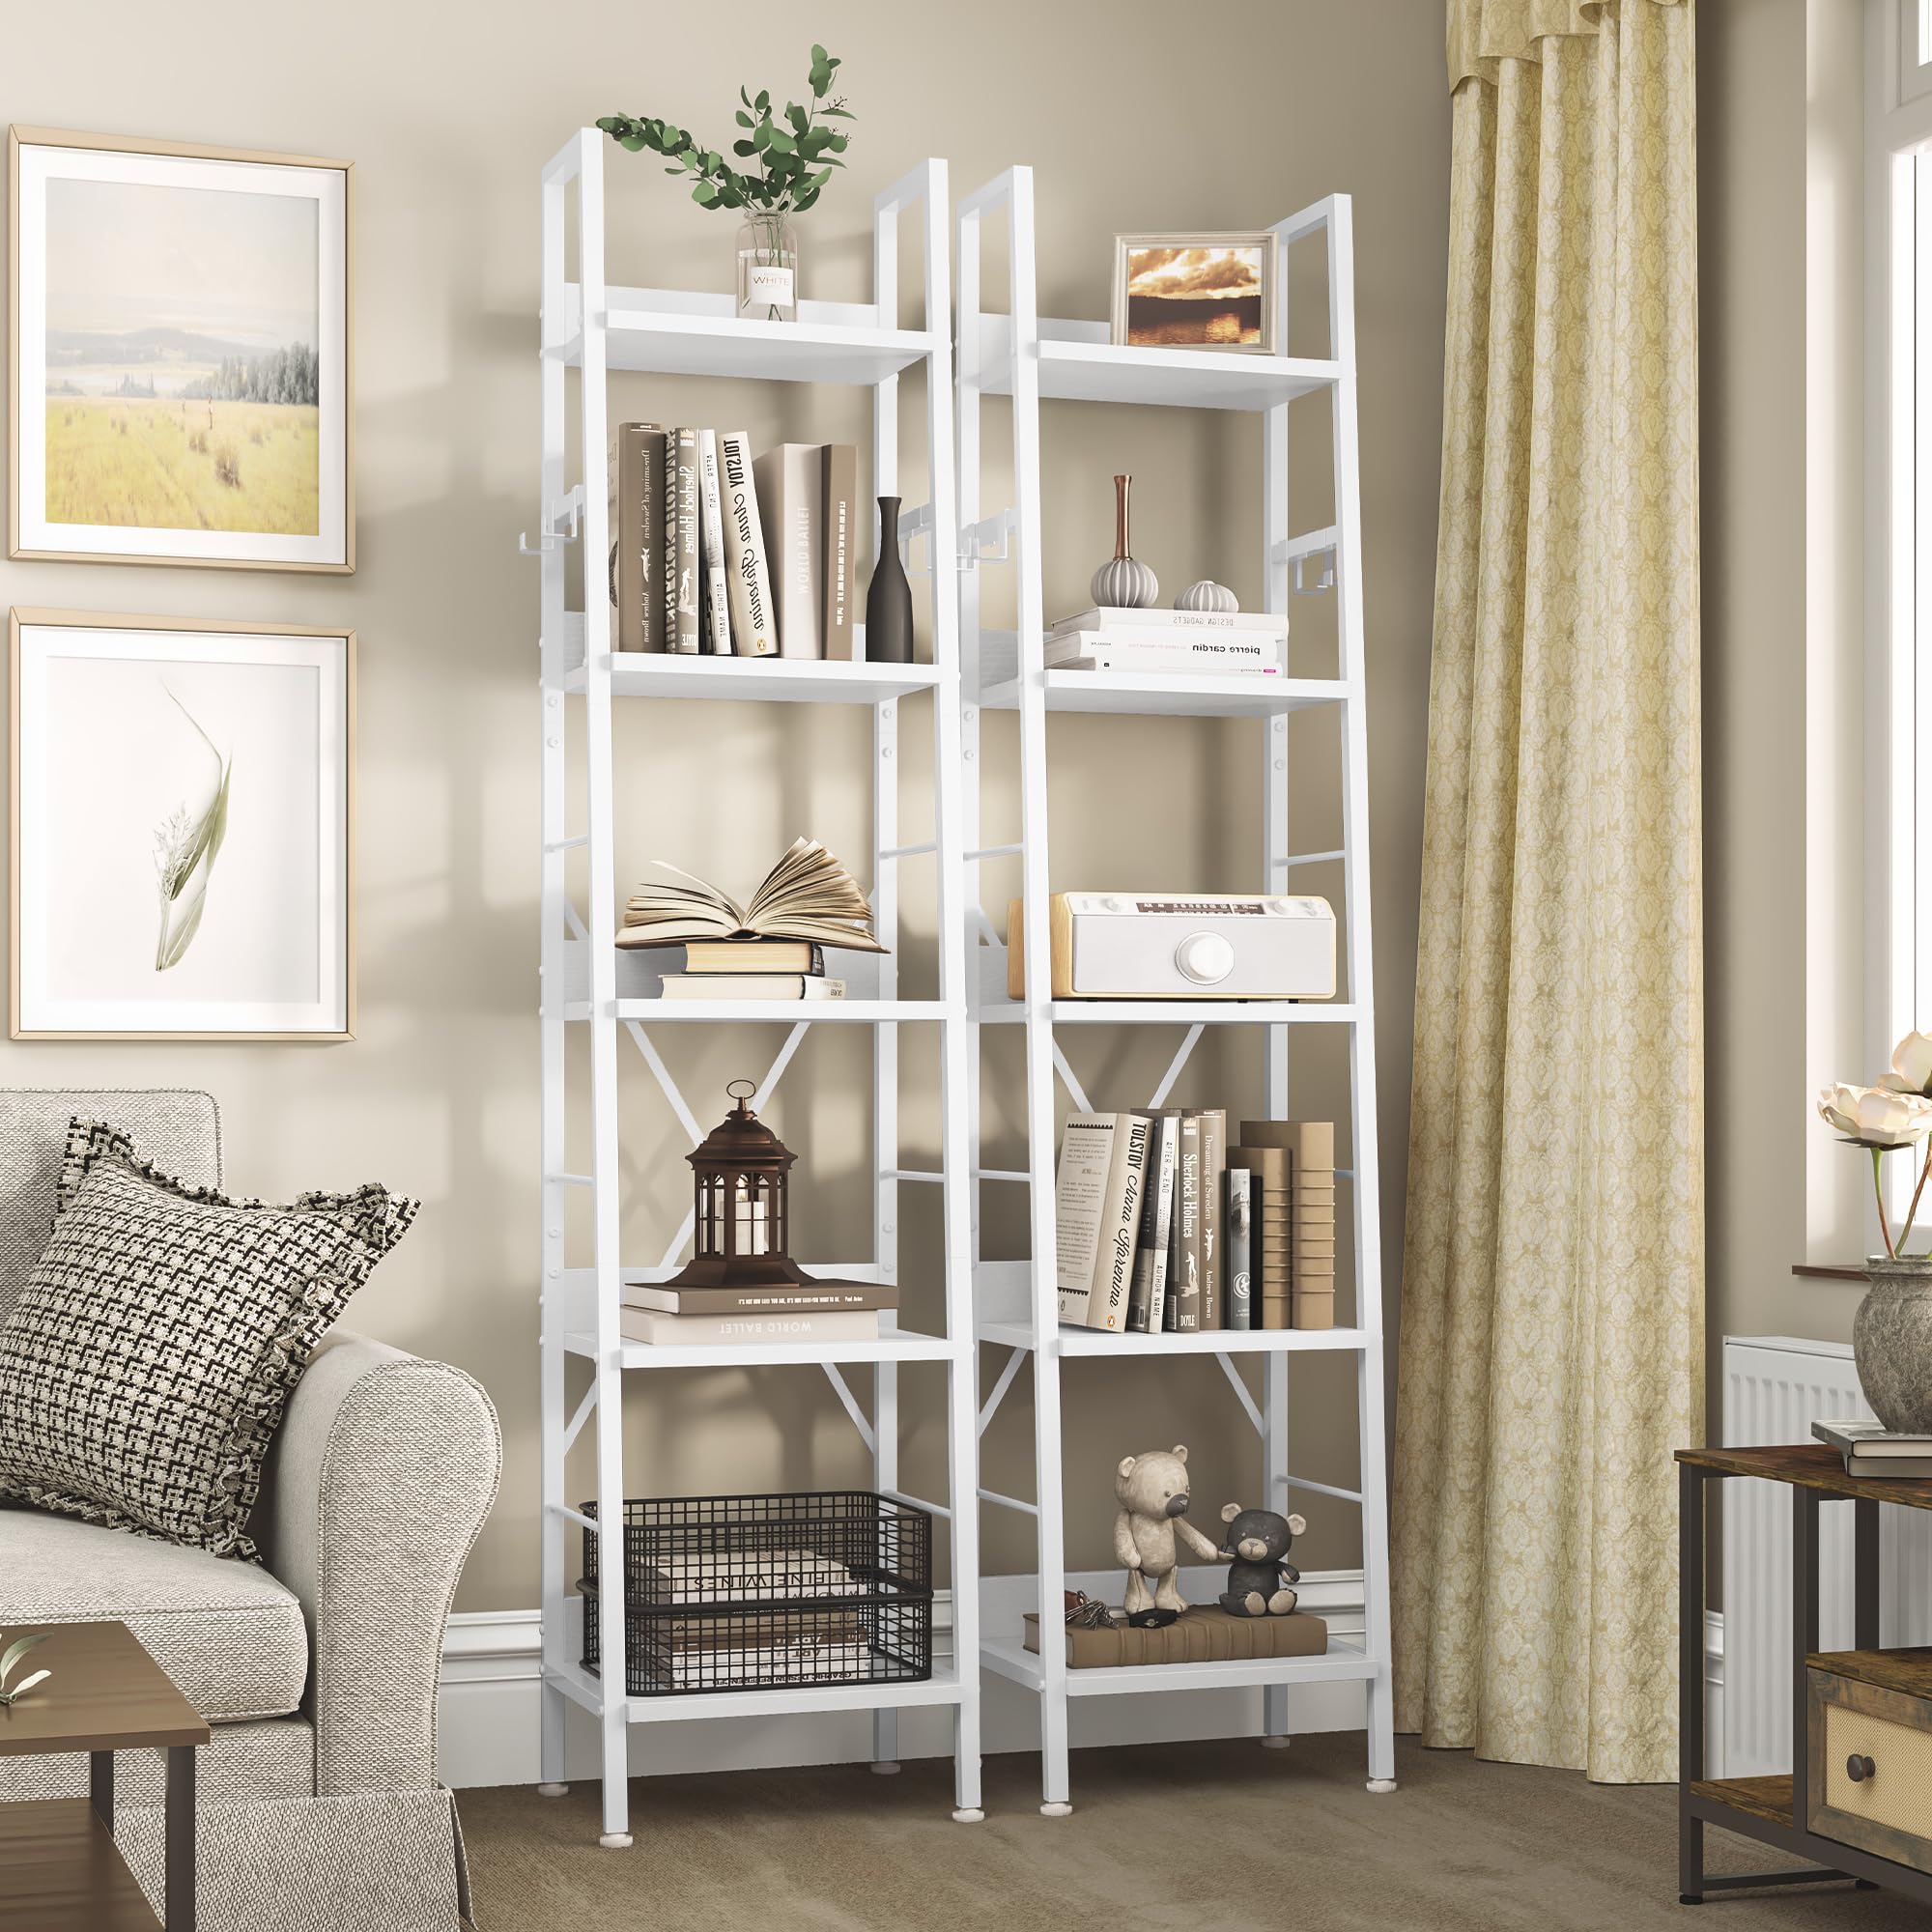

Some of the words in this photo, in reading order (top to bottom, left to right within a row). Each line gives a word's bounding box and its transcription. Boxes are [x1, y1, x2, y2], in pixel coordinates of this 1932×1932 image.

[753, 276, 789, 286] WHITE
[797, 507, 810, 547] BALLET
[797, 553, 810, 594] WORLD
[1127, 1123, 1147, 1171] TOLSTOY
[1164, 1141, 1173, 1164] AFTER
[1204, 1135, 1212, 1176] Dreaming
[1183, 1153, 1197, 1198] Sherlock
[1206, 1179, 1213, 1188] of
[1122, 1175, 1138, 1223] Anna
[1183, 1201, 1197, 1238] Holmes
[1110, 1228, 1130, 1308] Karenina
[720, 1322, 762, 1334] BALLET
[767, 1321, 811, 1332] WORLD
[695, 1576, 767, 1590] WINES
[778, 1573, 824, 1585] FINE
[792, 1648, 821, 1658] ART
